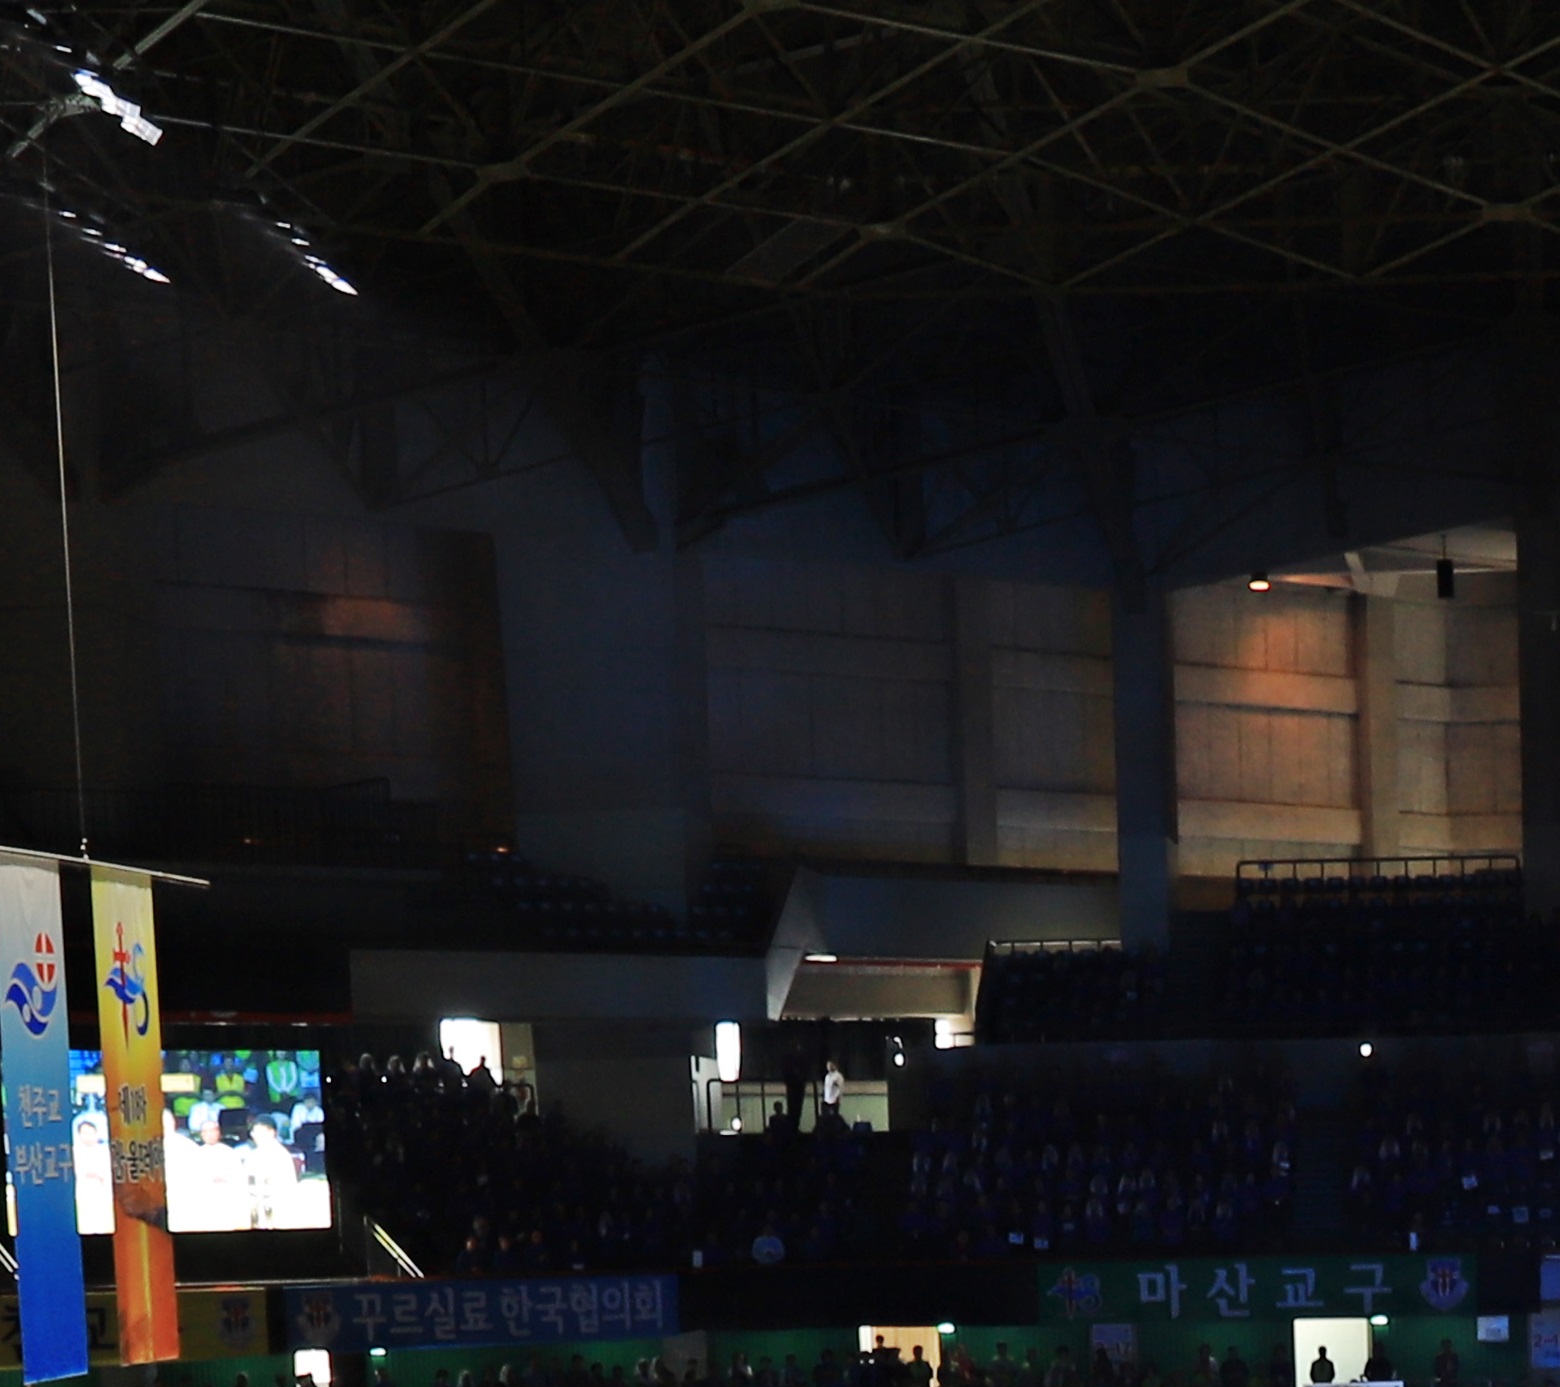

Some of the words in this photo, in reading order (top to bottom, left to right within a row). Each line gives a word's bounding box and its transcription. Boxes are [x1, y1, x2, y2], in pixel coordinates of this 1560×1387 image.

[18, 1086, 63, 1128] 천주교
[15, 1143, 73, 1184] 부산교구
[352, 1288, 493, 1343] 꾸르실료
[499, 1279, 665, 1337] 한국협의회
[1137, 1261, 1393, 1319] 마산교구
